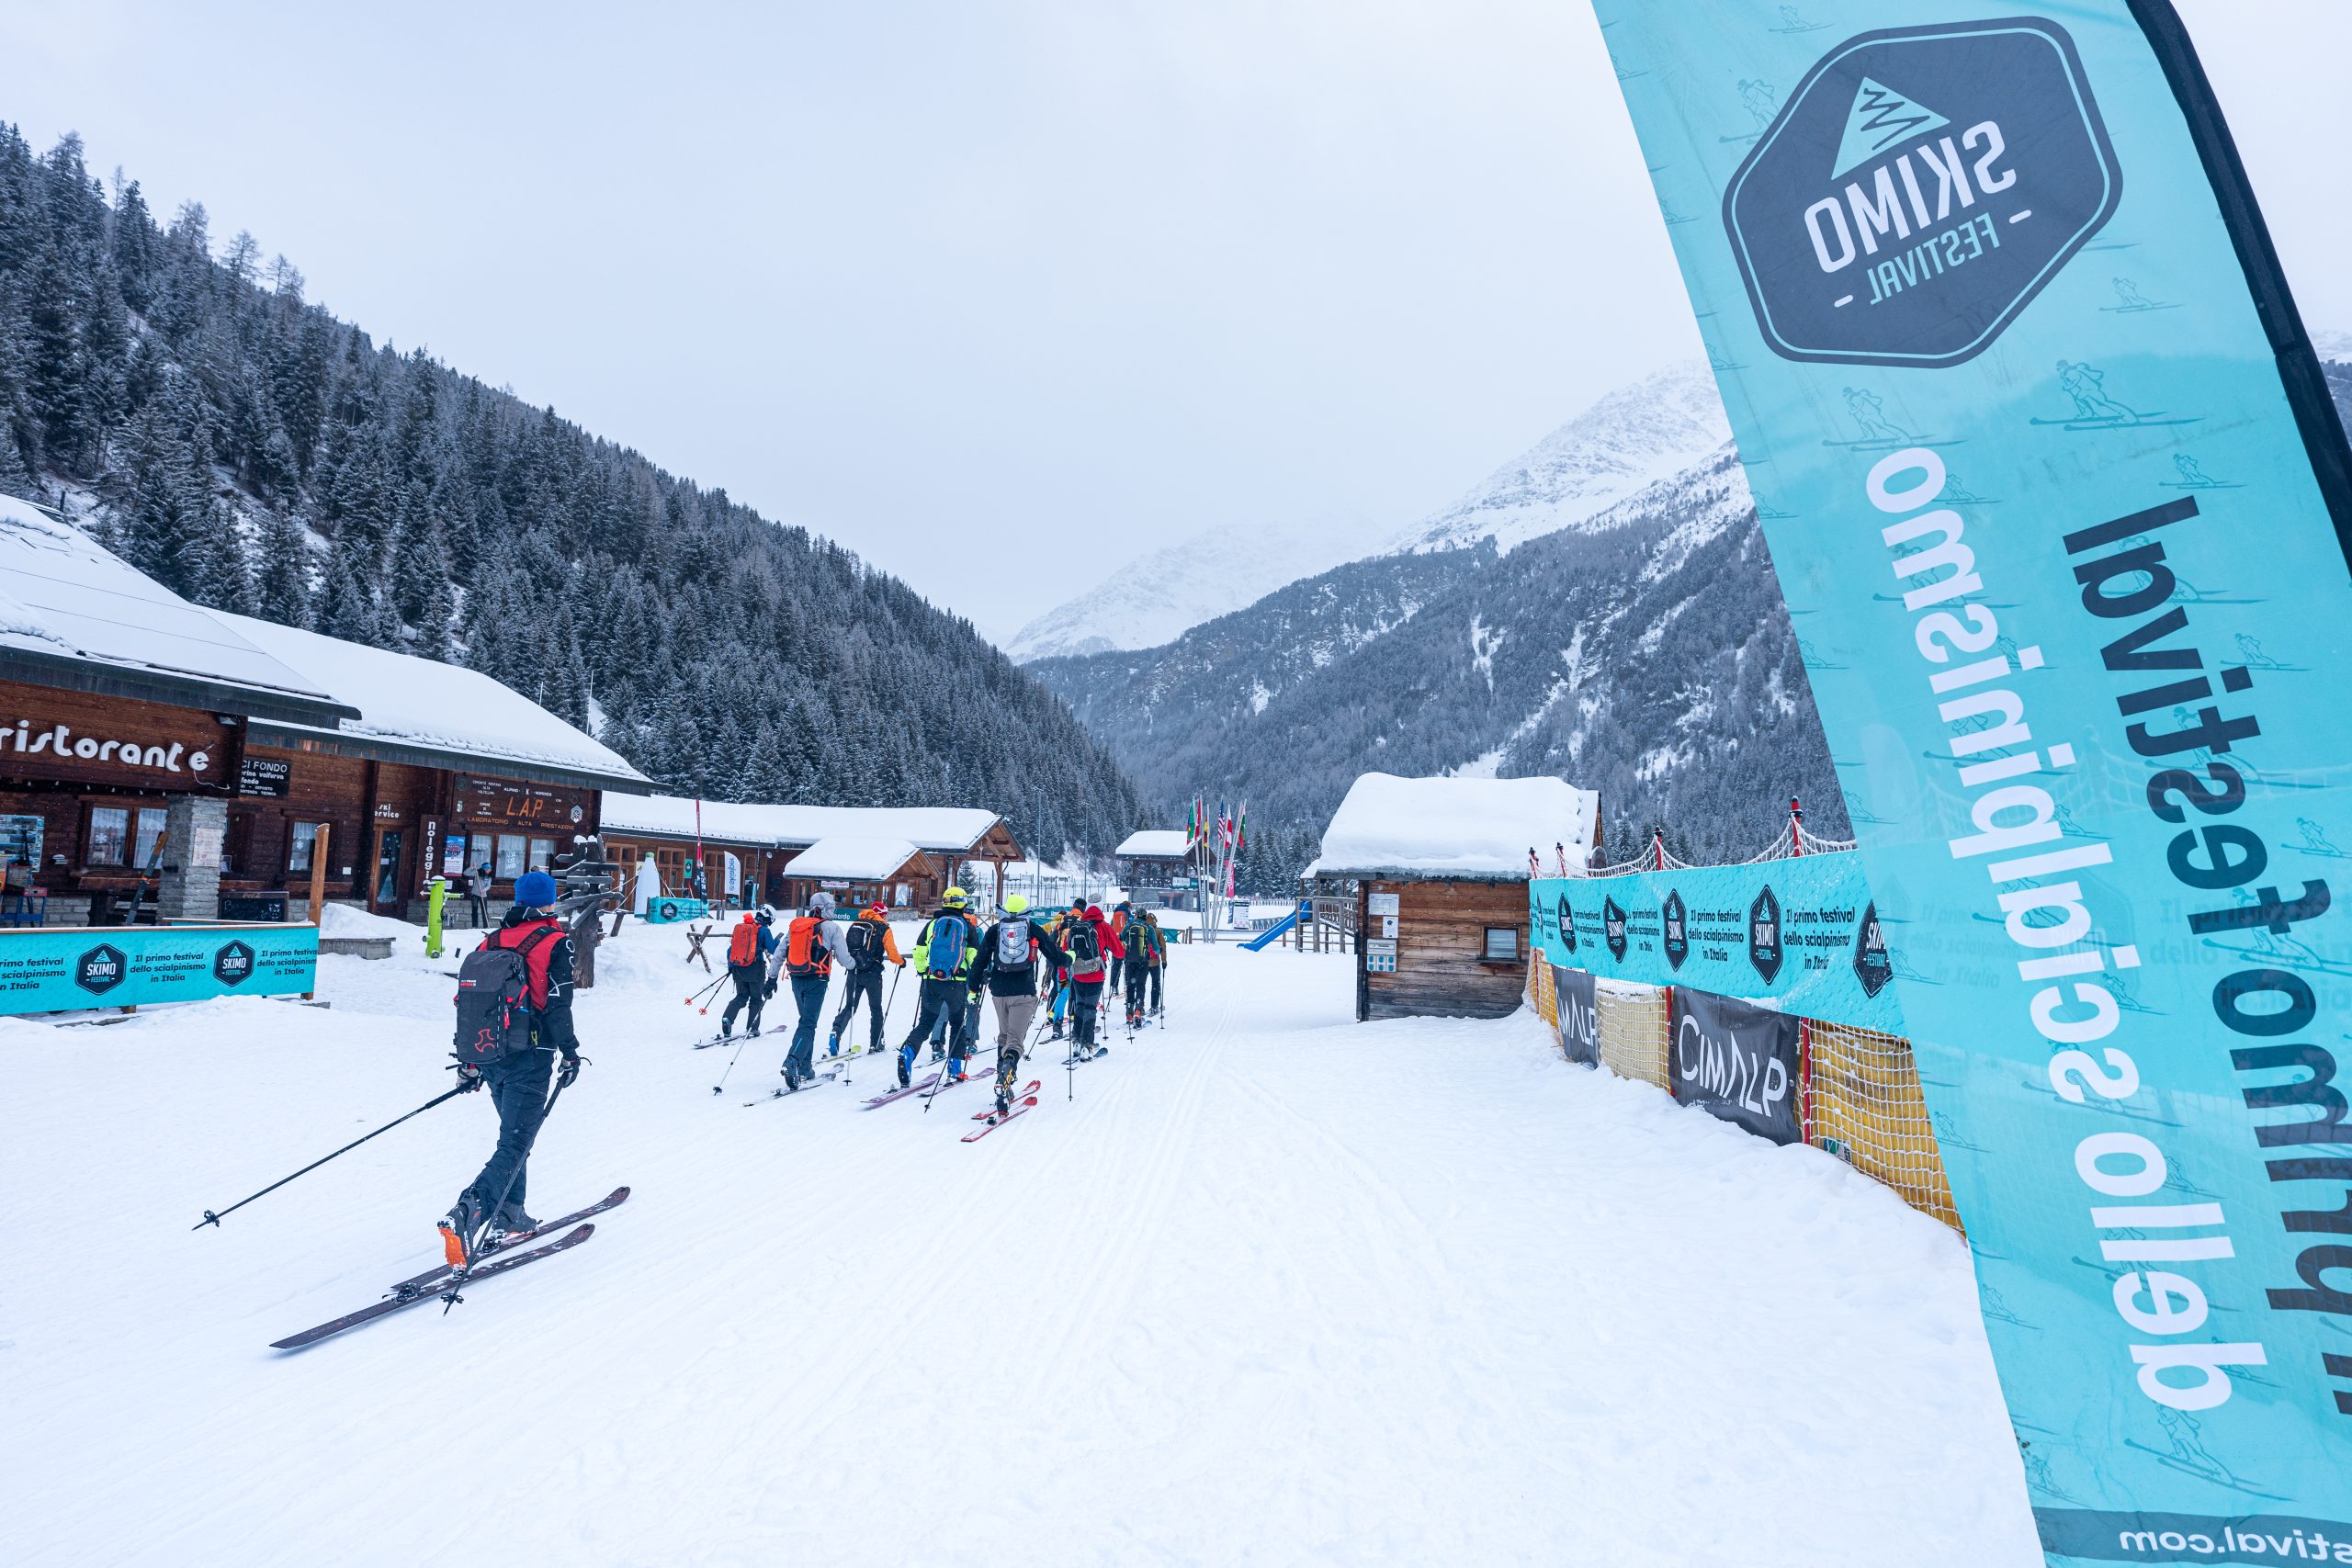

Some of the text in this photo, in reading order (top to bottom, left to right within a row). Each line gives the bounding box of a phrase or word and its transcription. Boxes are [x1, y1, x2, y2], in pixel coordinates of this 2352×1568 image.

[0, 719, 209, 773] ristorante
[254, 761, 288, 773] FONDO
[374, 810, 400, 818] ervice
[1690, 908, 1742, 925] Il primo festival
[1793, 907, 1818, 928] primo
[1819, 905, 1855, 924] festival
[1688, 927, 1745, 945] dello scialpinismo
[1755, 923, 1774, 947] SKIMO
[1783, 930, 1850, 951] dello scialpinismo
[135, 952, 204, 964] Il primo festival
[270, 949, 292, 958] primo
[293, 948, 318, 956] festiva
[1702, 946, 1728, 962] in Italia
[0, 957, 64, 967] rimo festival
[222, 957, 247, 970] SKIMO
[256, 957, 317, 967] dello scialpinism
[1804, 953, 1812, 970] in
[86, 963, 117, 976] SKIMO
[130, 962, 207, 974] dello scialpinismo
[283, 967, 305, 976] Italia
[1, 969, 67, 980] scialpinismo
[151, 973, 186, 983] in Italia
[10, 980, 40, 991] Italia
